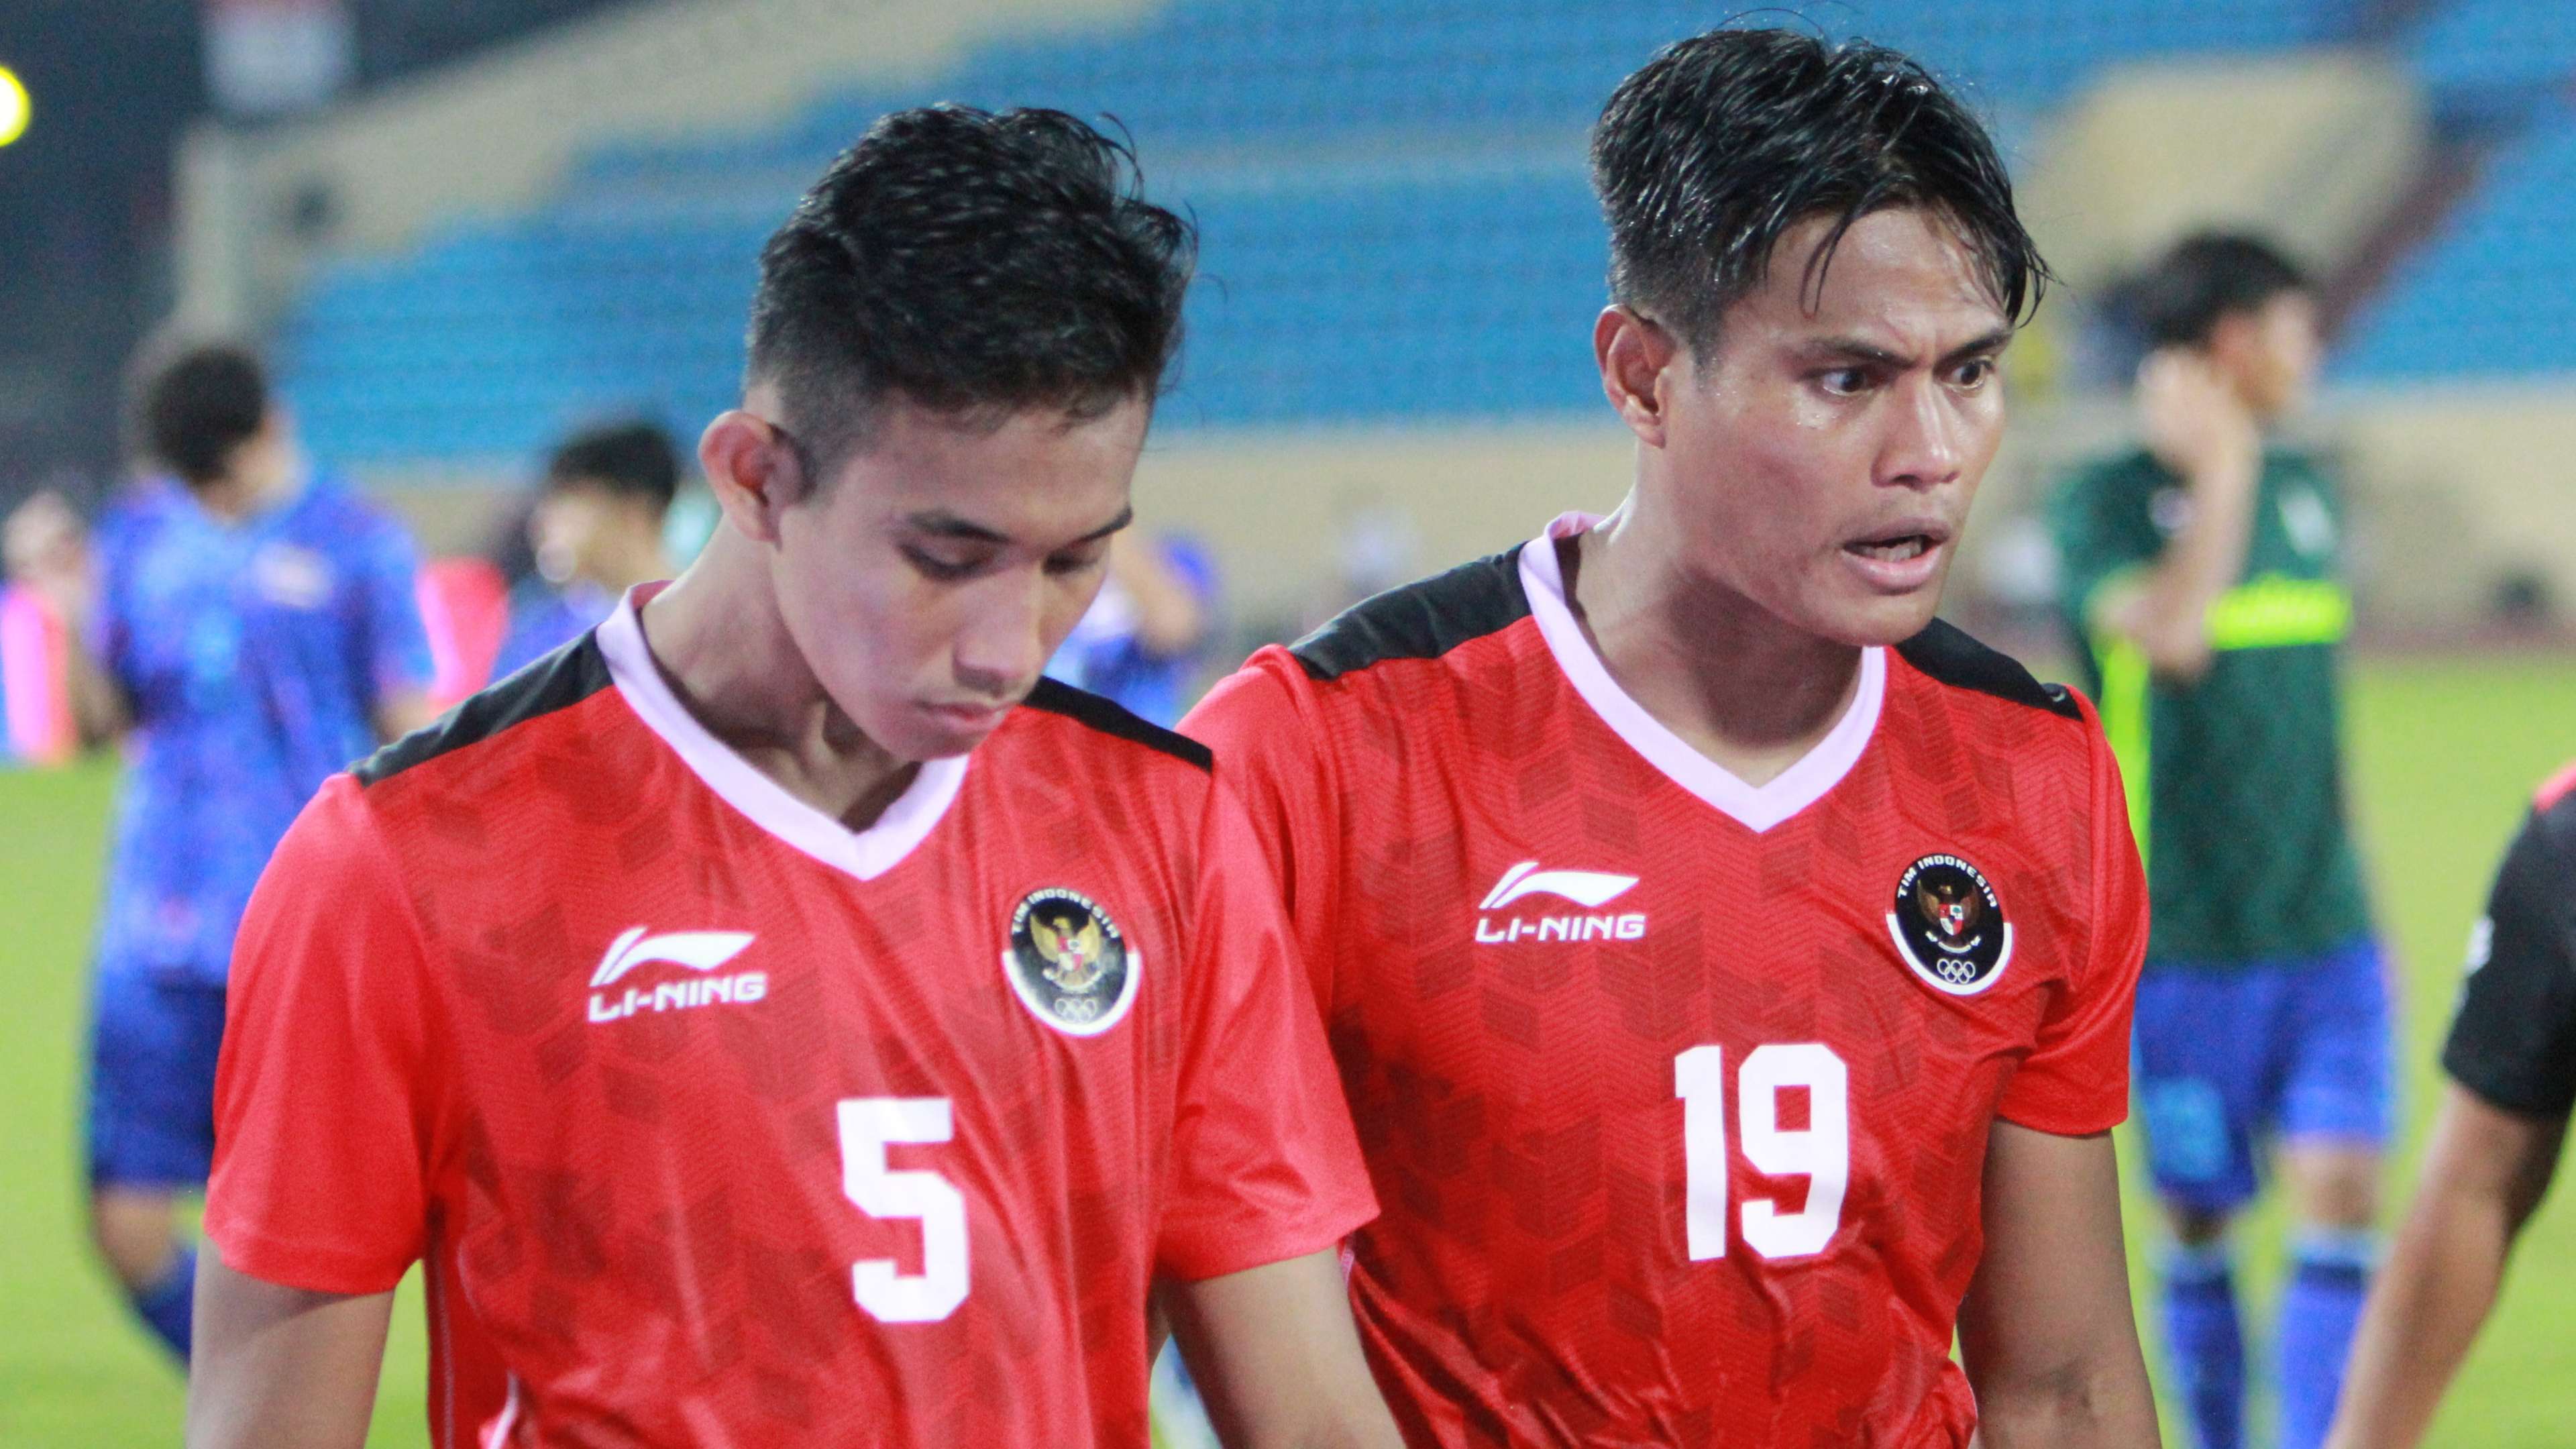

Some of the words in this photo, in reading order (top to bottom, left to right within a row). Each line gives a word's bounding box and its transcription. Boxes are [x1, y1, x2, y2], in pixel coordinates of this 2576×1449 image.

[1898, 867, 1917, 898] TIM
[1917, 855, 1998, 907] INDONESIA
[1475, 913, 1646, 943] LI-NING
[588, 973, 767, 1022] LI-NING
[1674, 1042, 1849, 1261] 19
[837, 1096, 970, 1323] 5
